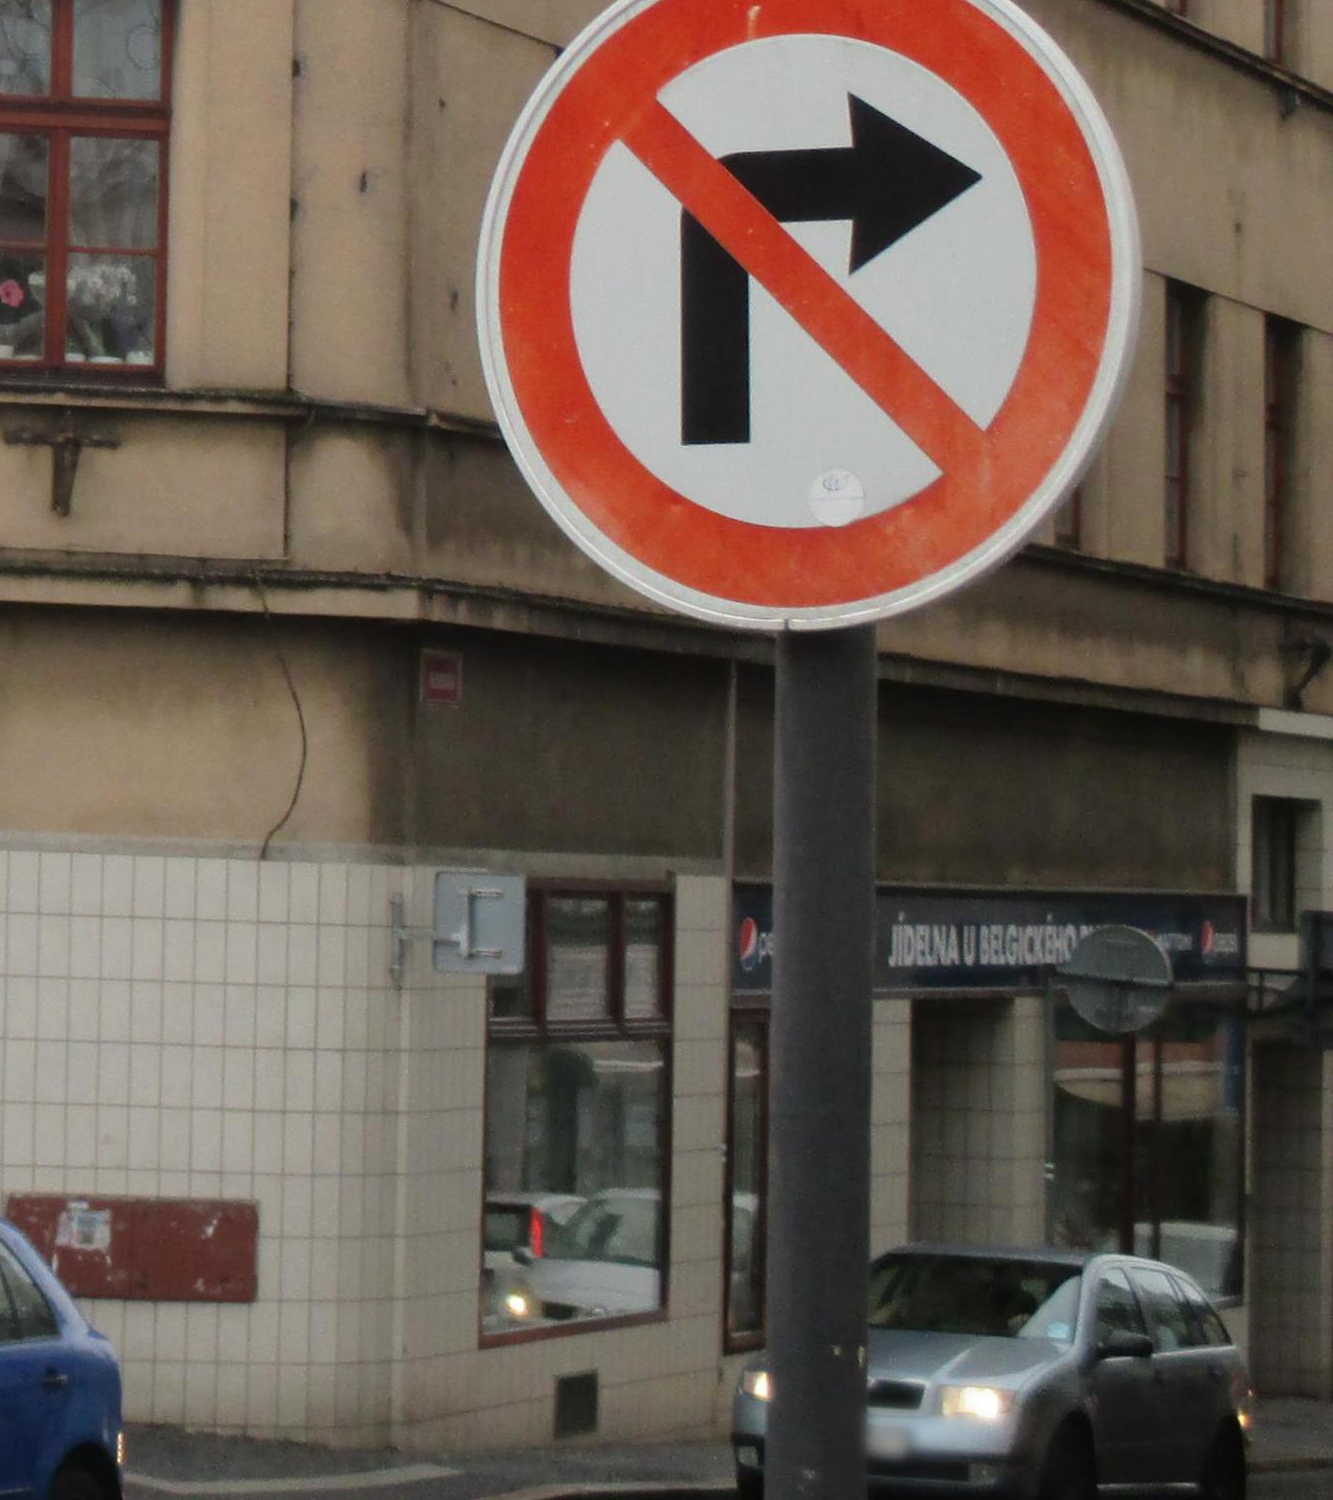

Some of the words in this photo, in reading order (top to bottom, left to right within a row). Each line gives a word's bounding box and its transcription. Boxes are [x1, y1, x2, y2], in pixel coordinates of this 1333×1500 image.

[887, 910, 962, 968] JÍDELNA
[962, 923, 977, 967] U
[979, 910, 1078, 966] BELGICKÉHO
